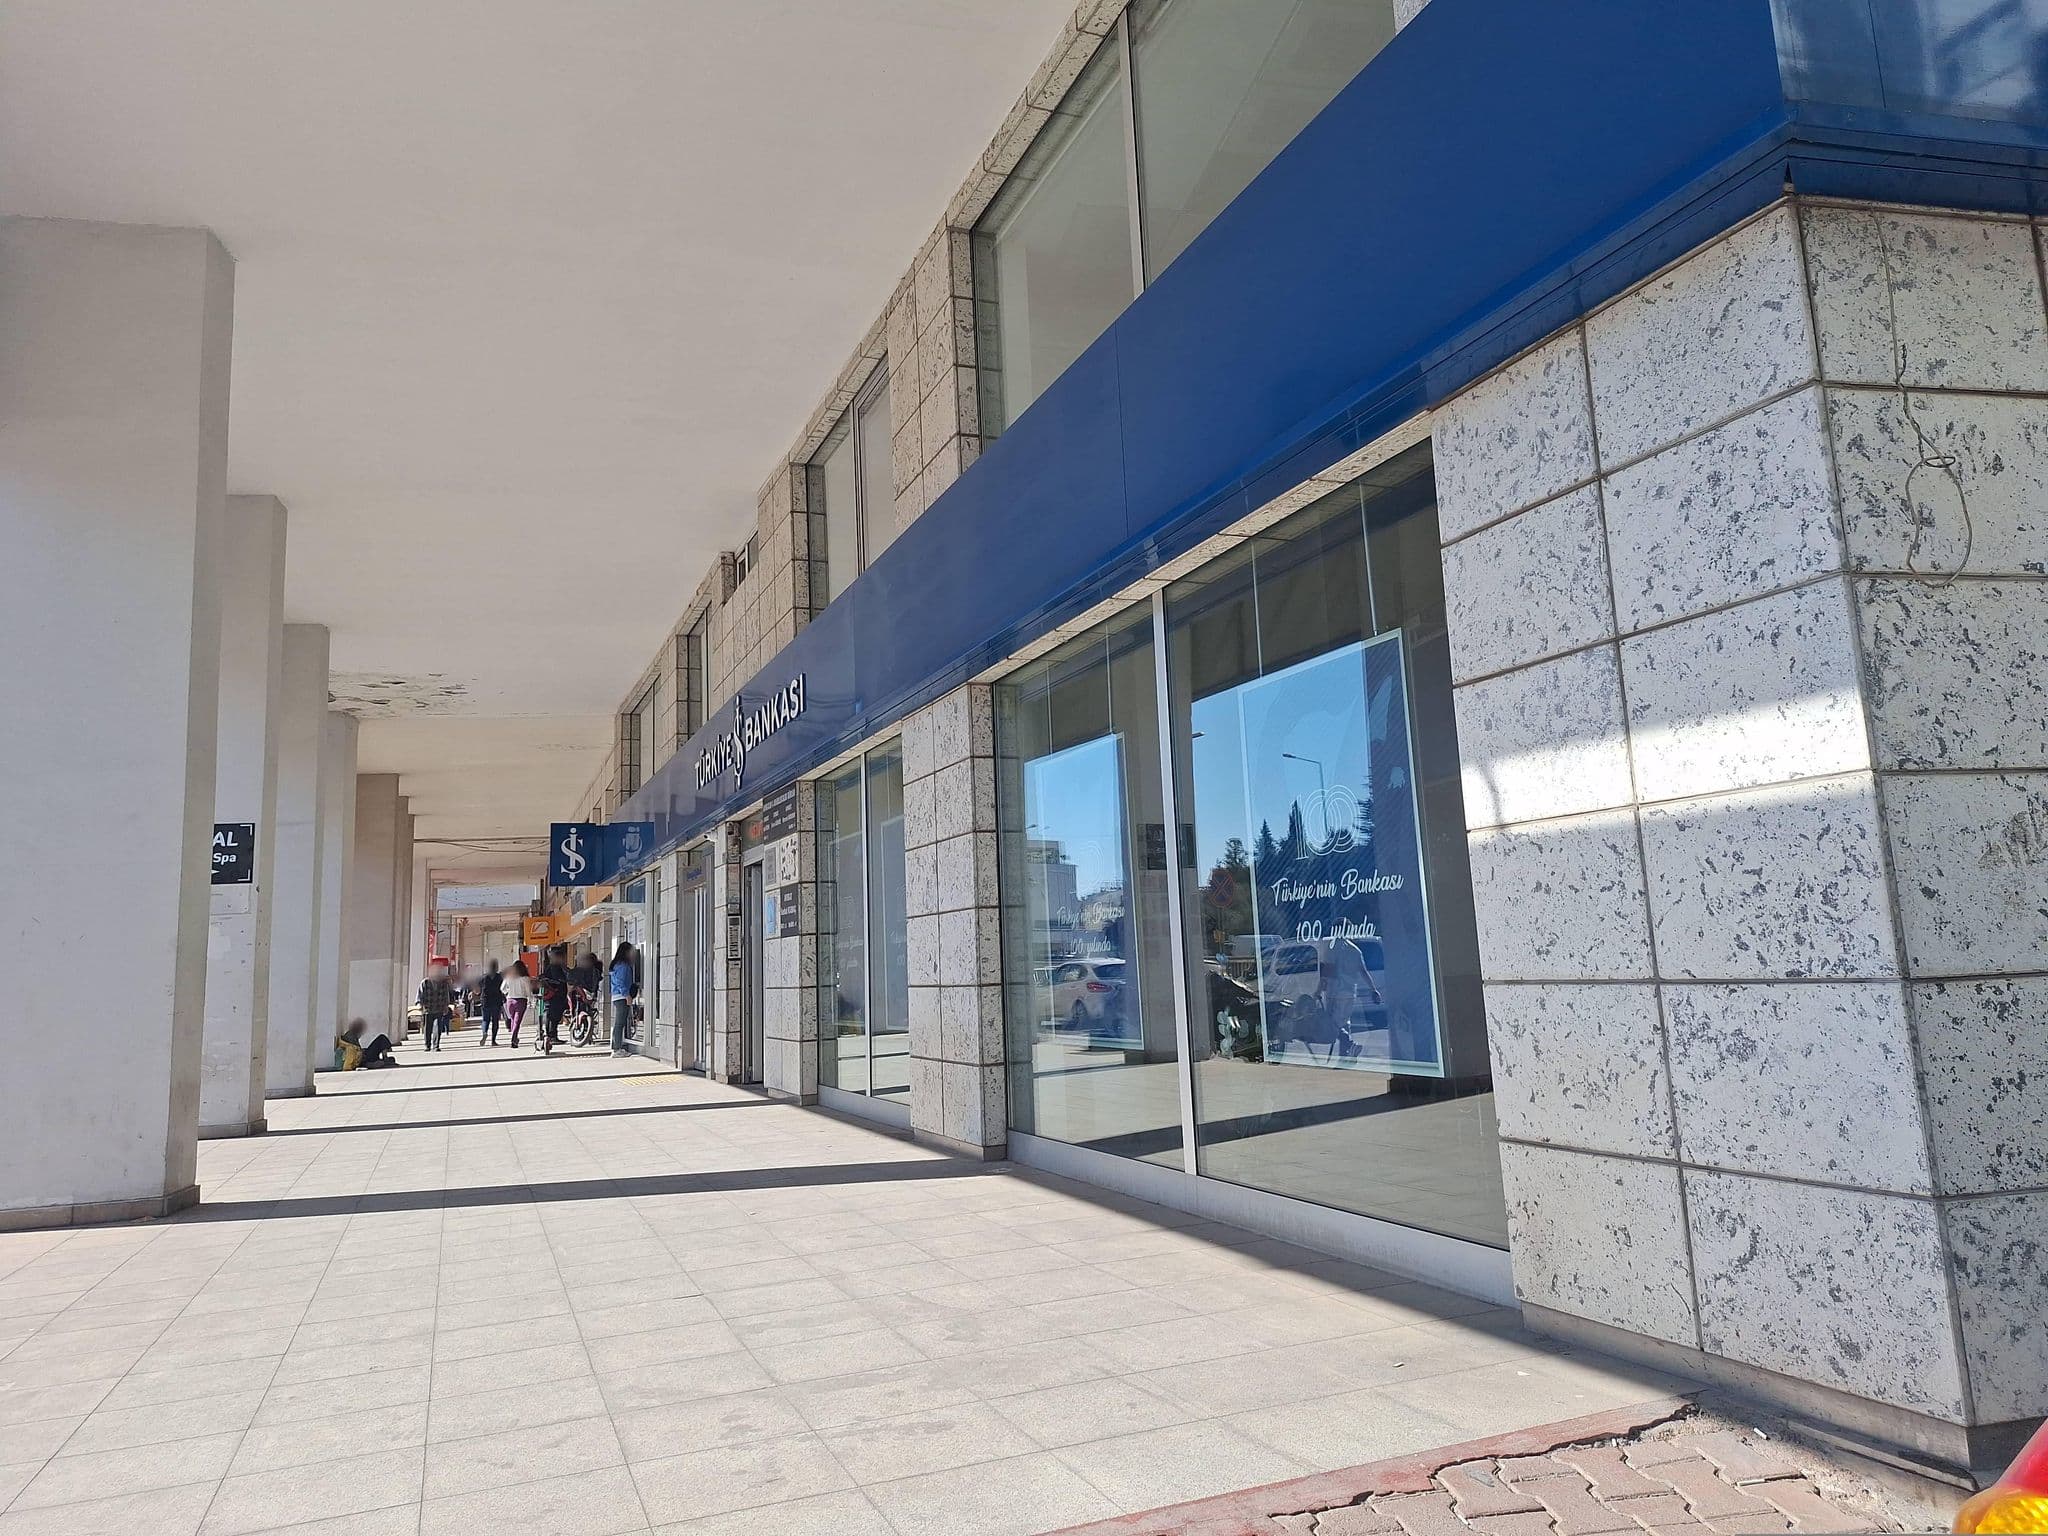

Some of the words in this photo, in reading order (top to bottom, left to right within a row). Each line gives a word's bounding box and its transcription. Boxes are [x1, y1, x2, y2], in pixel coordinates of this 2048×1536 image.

[694, 732, 733, 790] TÜRKİYE
[745, 673, 806, 752] BANKASI
[213, 852, 237, 866] Spa
[1271, 877, 1337, 909] Türkiye'nin
[1340, 868, 1404, 900] Bankası
[1296, 919, 1322, 943] 100
[1329, 915, 1377, 949] yılında
